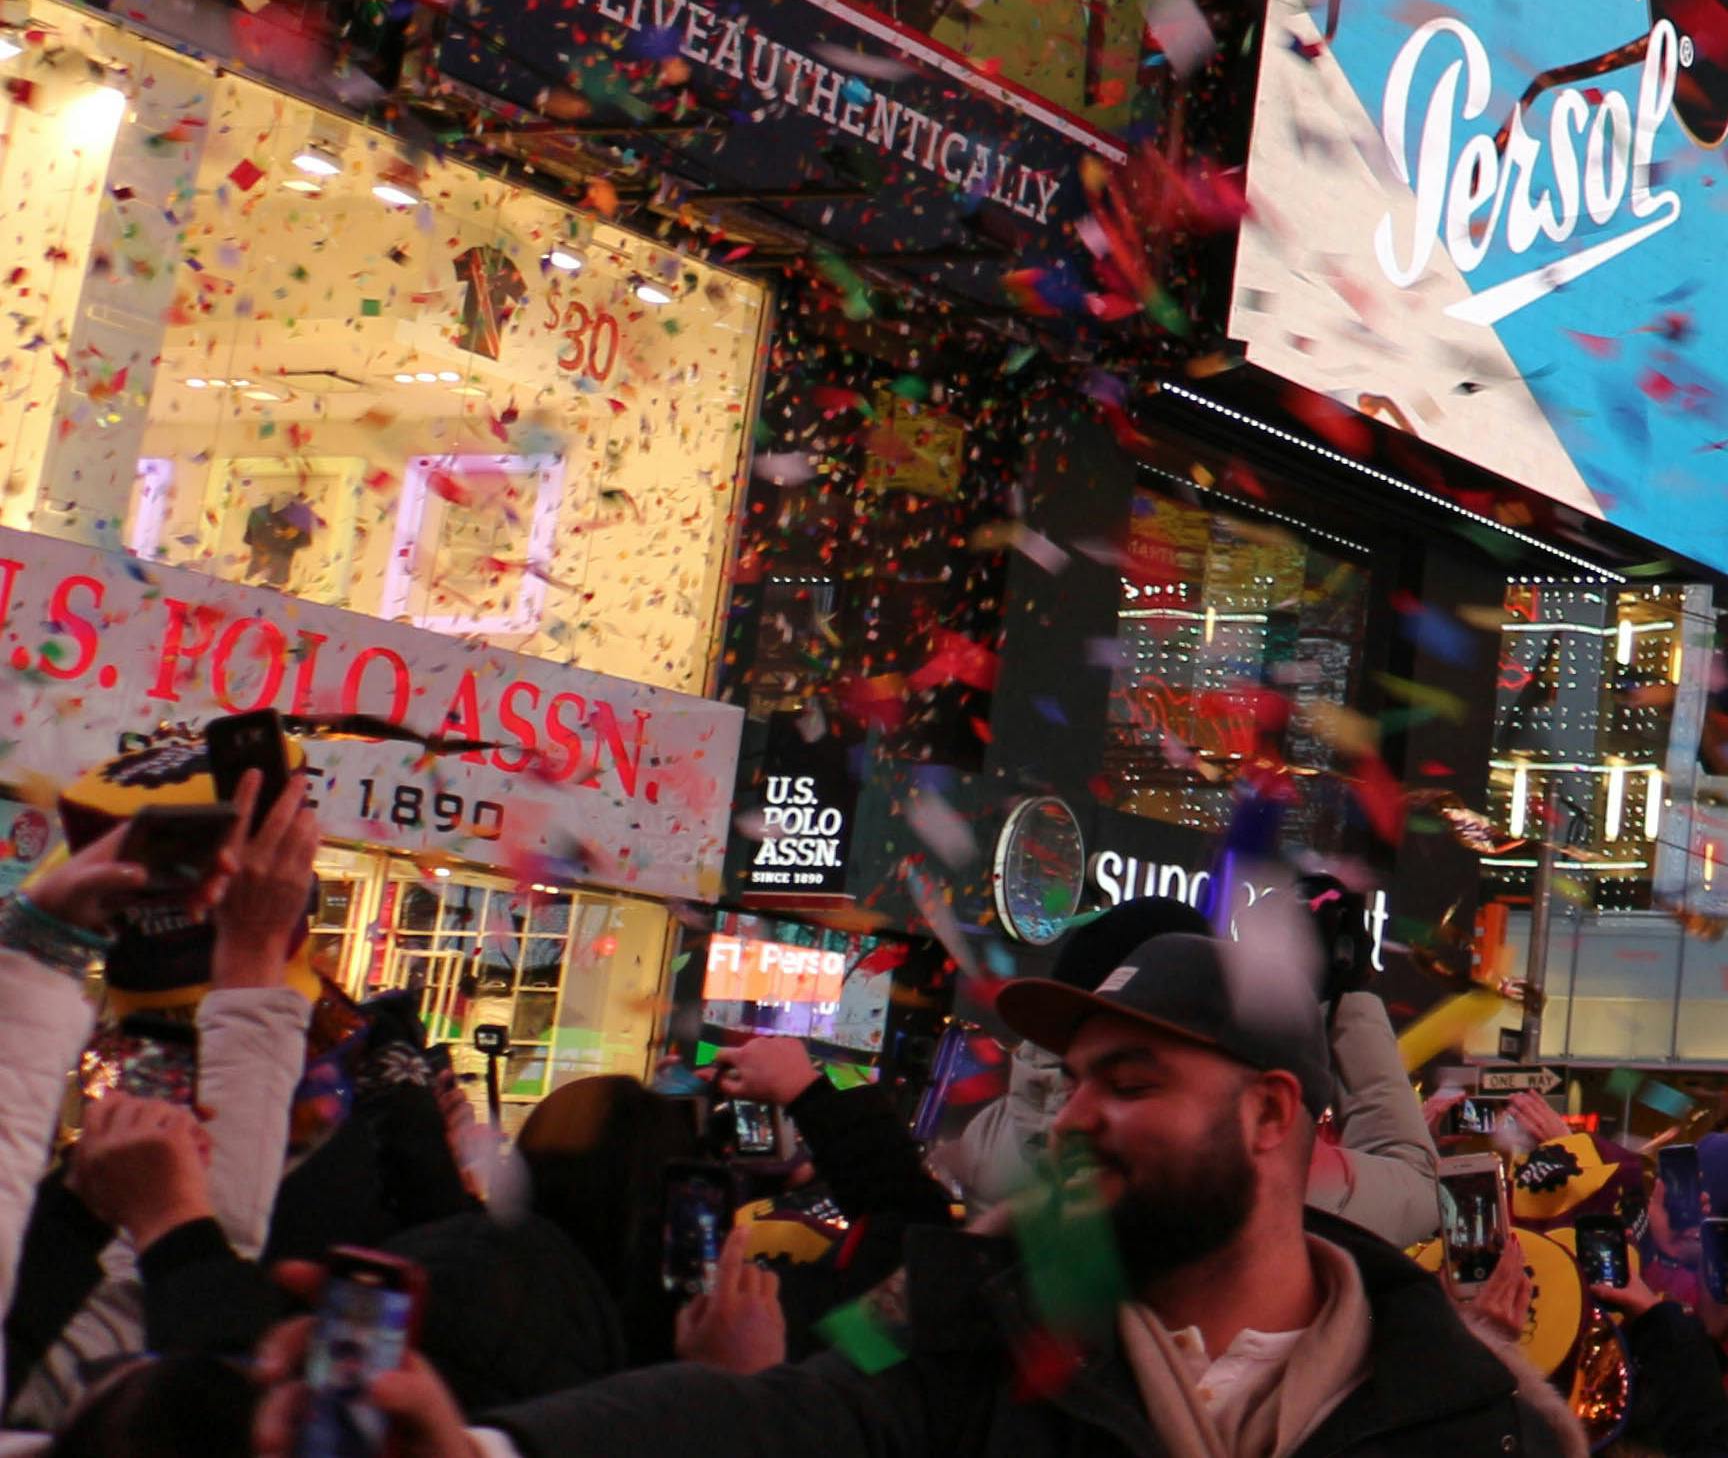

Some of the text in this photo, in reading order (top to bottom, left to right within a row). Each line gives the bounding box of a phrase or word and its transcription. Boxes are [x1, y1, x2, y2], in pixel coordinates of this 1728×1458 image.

[1373, 17, 1680, 290] Persol
[147, 597, 411, 742] POLO
[430, 668, 662, 805] ASSN.
[766, 775, 819, 805] U.S.
[358, 775, 506, 842] 1890
[763, 806, 843, 837] POLO
[752, 837, 843, 867] ASSN.
[751, 871, 824, 885] SINCE 1890
[1489, 1072, 1553, 1089] ONE WAY
